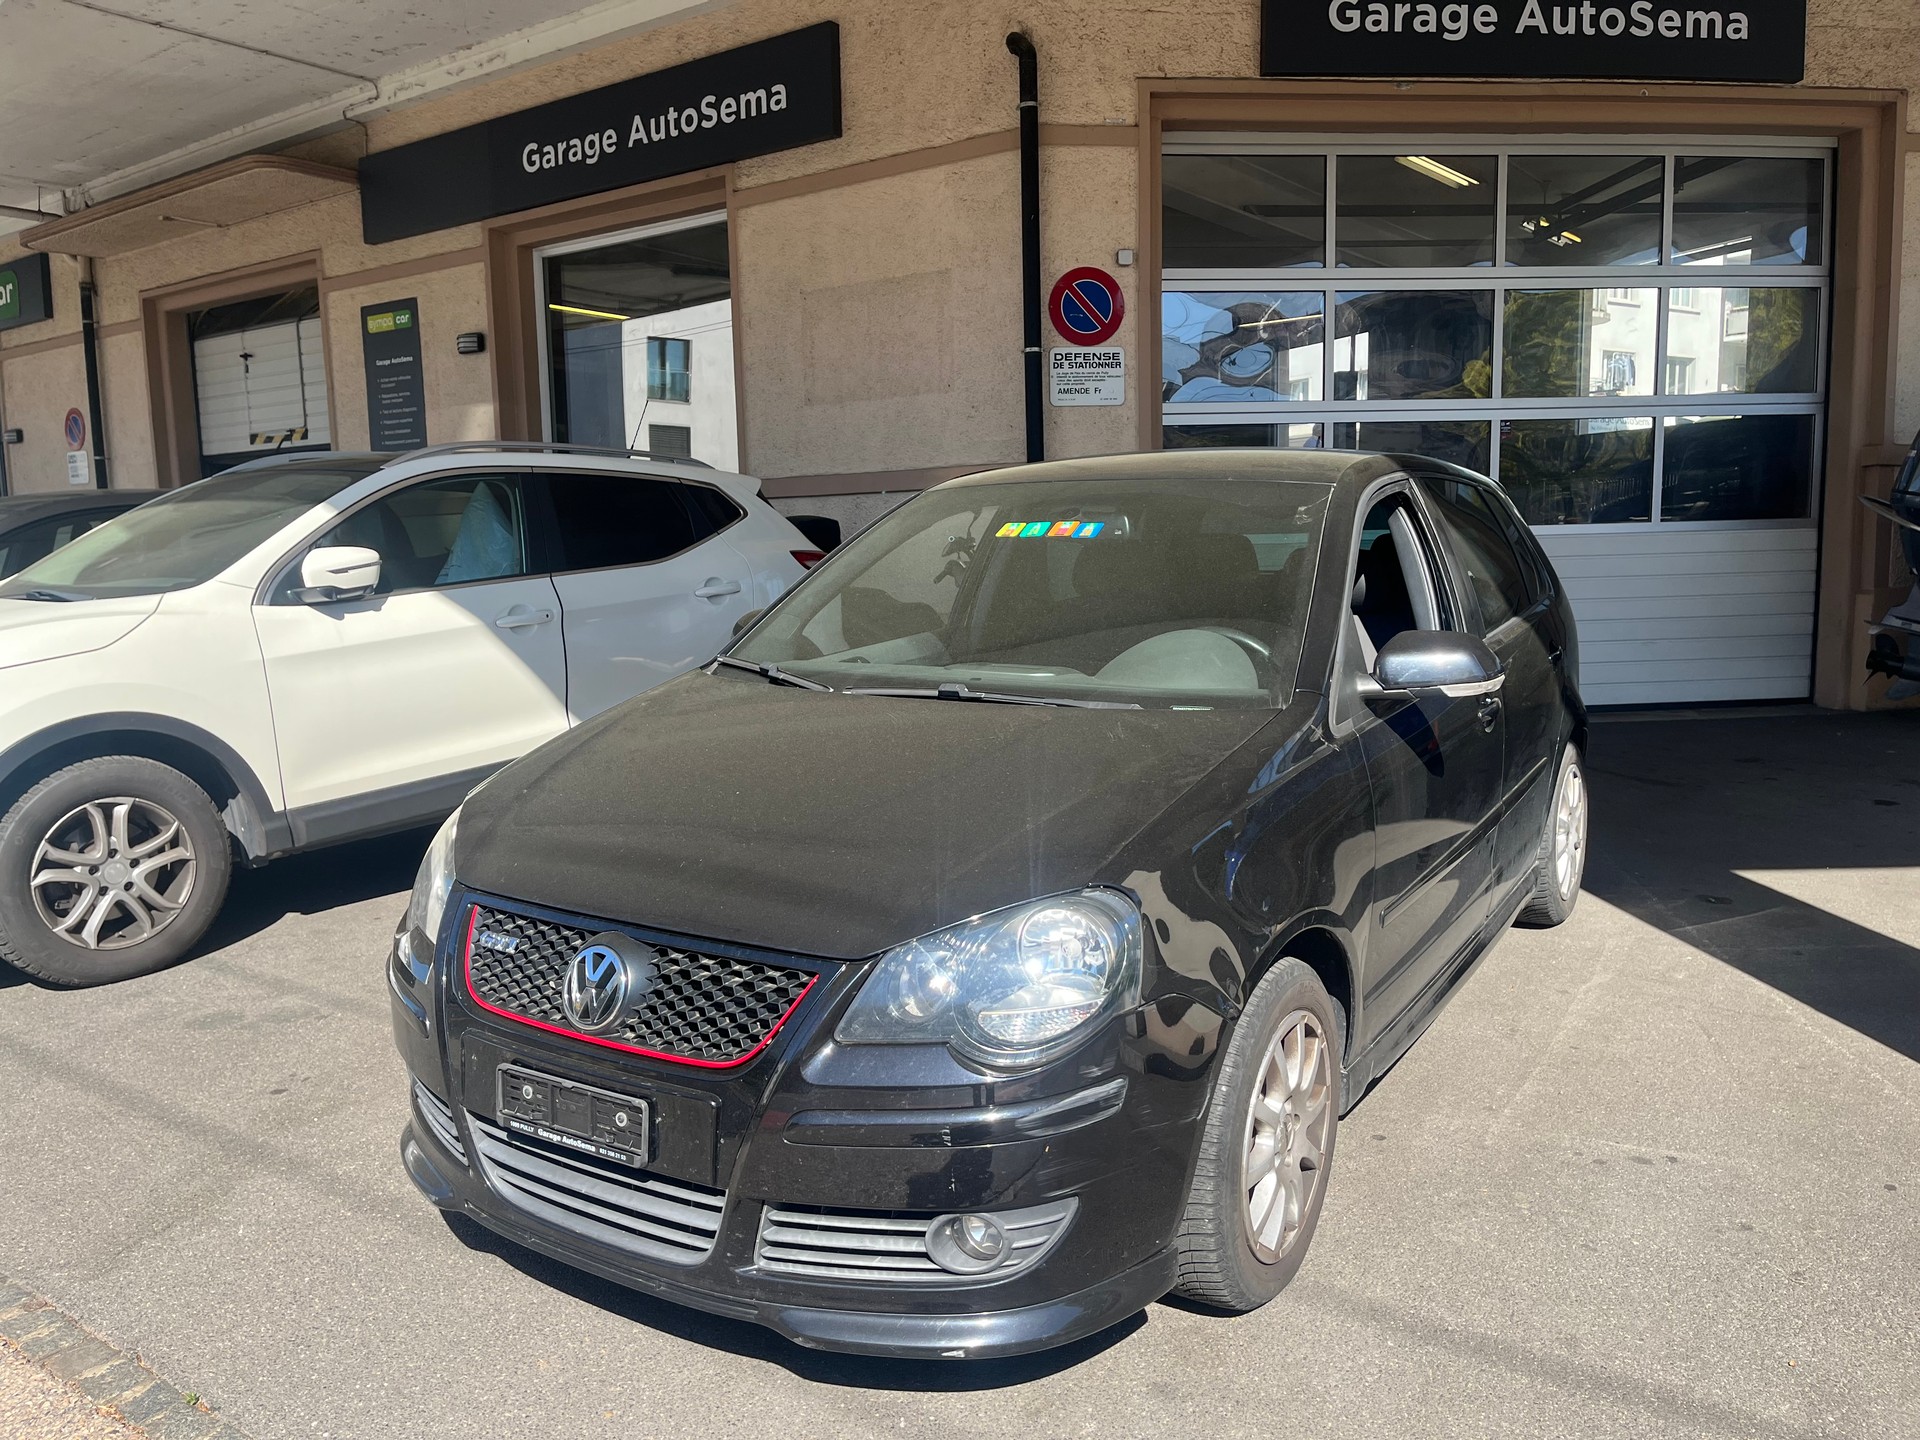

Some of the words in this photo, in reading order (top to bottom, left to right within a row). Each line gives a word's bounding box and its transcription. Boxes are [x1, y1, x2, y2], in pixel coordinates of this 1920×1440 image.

[1328, 0, 1498, 41] Garage
[1515, 0, 1749, 40] AutoSema
[522, 128, 618, 173] Garage
[628, 83, 788, 149] AutoSema
[395, 314, 410, 324] car
[1053, 361, 1065, 369] DE
[1067, 361, 1122, 369] STATIONNER
[1057, 387, 1091, 395] AMENDE
[1094, 387, 1102, 395] Fr
[537, 1128, 561, 1142] Garage
[562, 1135, 596, 1152] AutoSema
